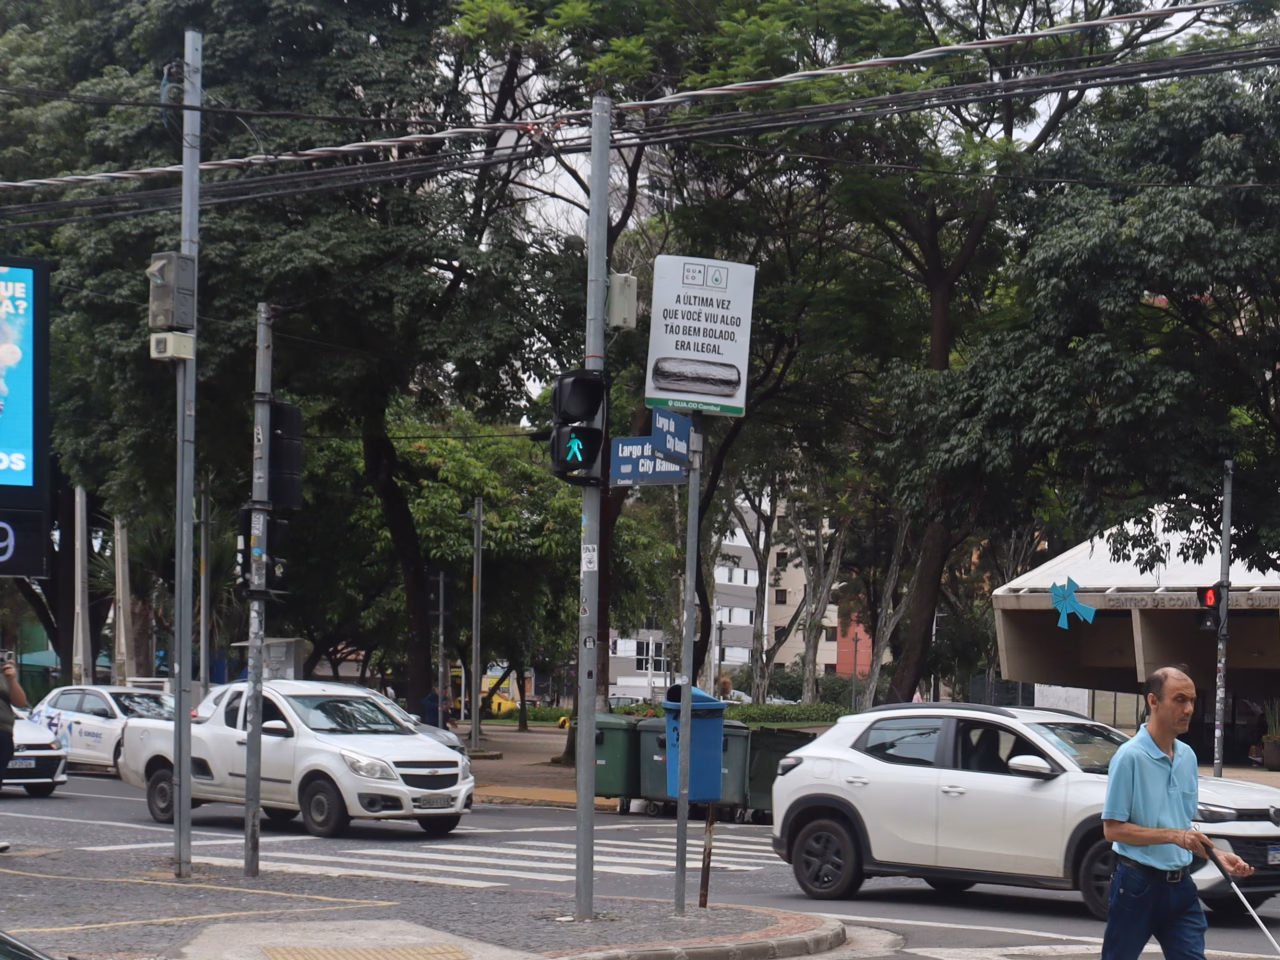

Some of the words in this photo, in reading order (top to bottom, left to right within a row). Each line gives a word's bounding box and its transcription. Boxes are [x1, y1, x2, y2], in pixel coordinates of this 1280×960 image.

[675, 294, 681, 305] A
[683, 292, 714, 308] ÚLTIMA
[716, 298, 731, 311] VEZ
[662, 308, 679, 321] QUE
[681, 309, 702, 322] VOCÊ
[704, 312, 719, 324] VIU
[720, 314, 742, 328] ALGO
[664, 322, 680, 335] TÃO
[682, 325, 701, 337] BEM
[702, 327, 737, 344] BOLADO,
[675, 340, 691, 352] ERA
[693, 341, 724, 356] ILEGAL.
[674, 400, 698, 408] GUA.CO
[618, 443, 642, 458] Largo
[638, 458, 654, 474] City
[1108, 597, 1148, 608] CENTRO
[1152, 597, 1165, 608] DE
